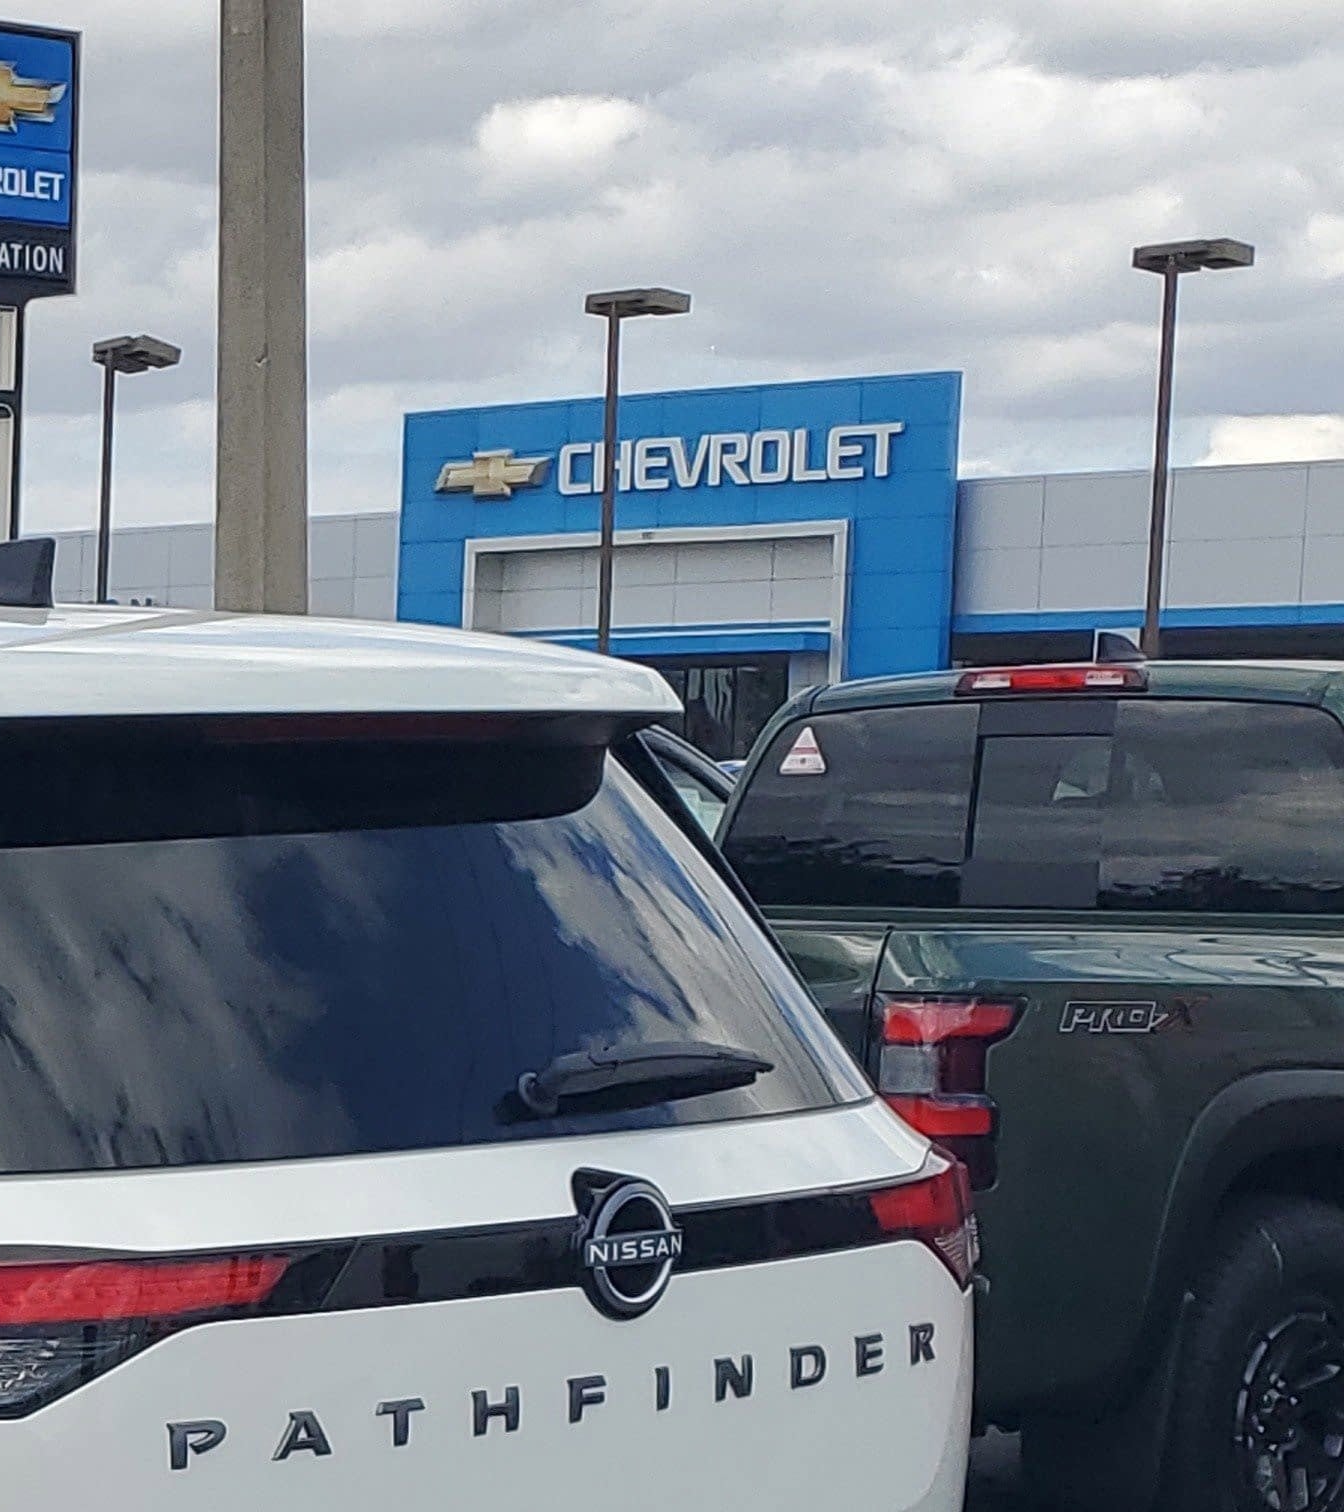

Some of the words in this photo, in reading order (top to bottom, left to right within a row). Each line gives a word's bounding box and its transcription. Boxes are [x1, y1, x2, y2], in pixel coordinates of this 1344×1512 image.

[558, 420, 906, 497] CHEVROLET
[589, 1233, 683, 1264] NISSAN
[164, 1322, 937, 1472] PATHFINDER
